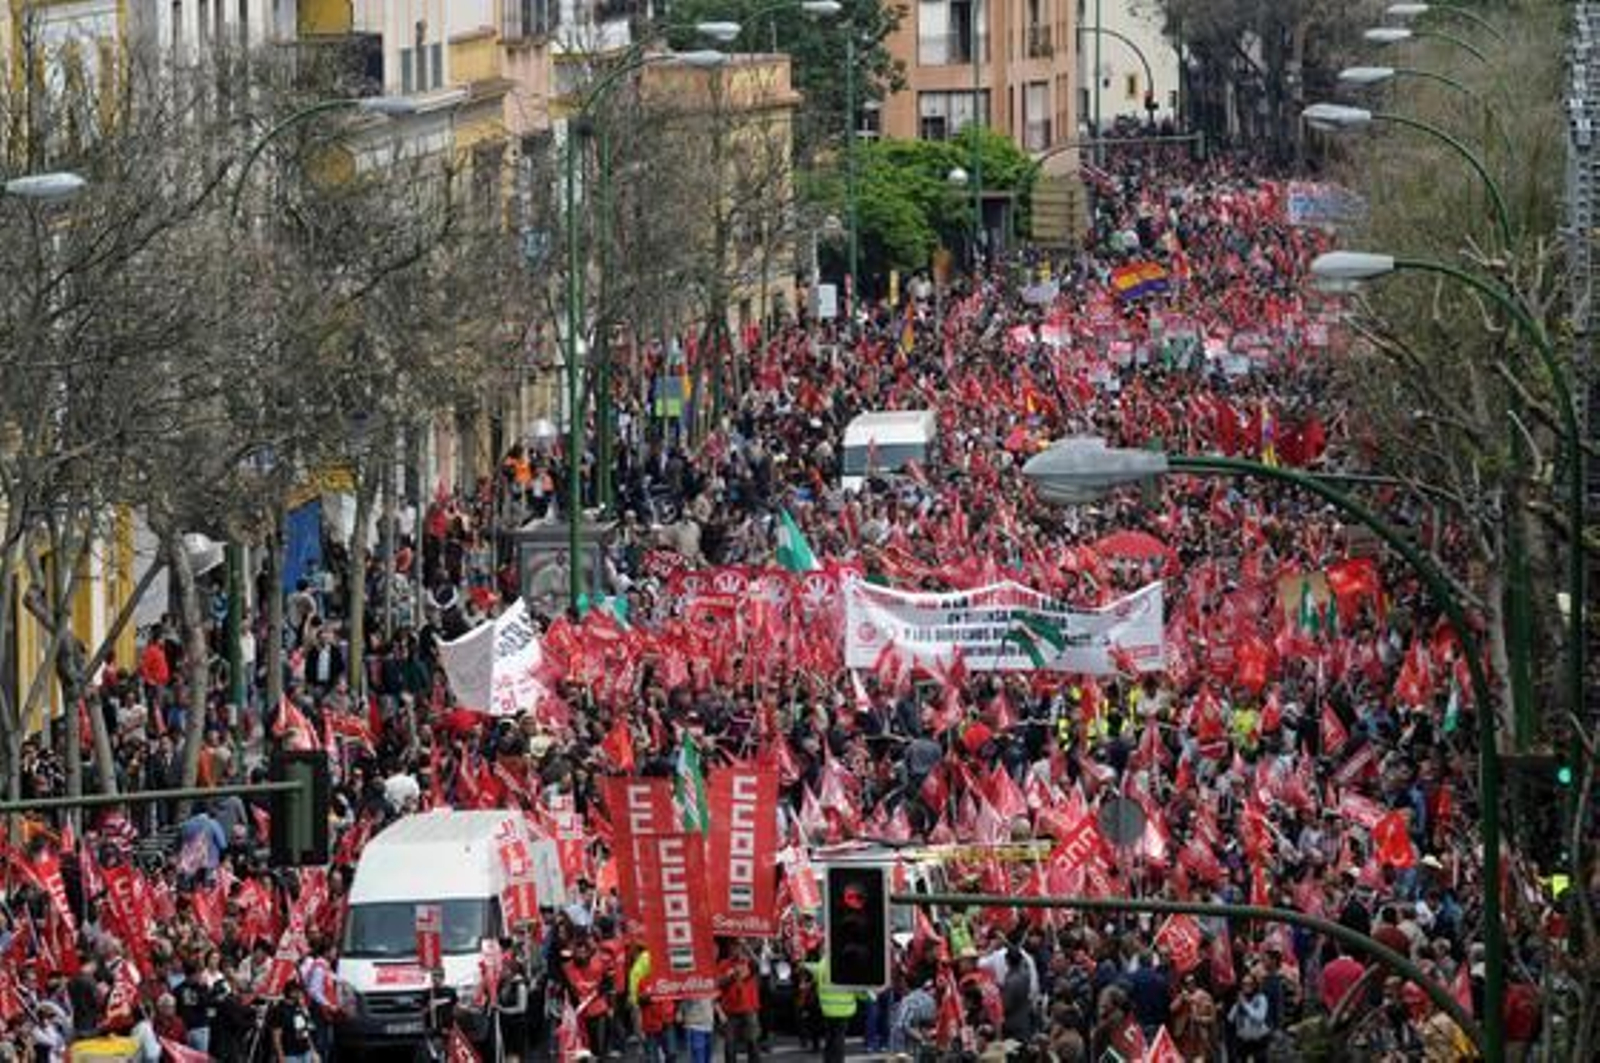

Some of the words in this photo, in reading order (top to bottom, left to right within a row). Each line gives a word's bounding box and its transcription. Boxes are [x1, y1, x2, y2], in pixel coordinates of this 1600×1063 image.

[729, 775, 757, 884] CCOO
[658, 838, 692, 945] CCOO
[712, 913, 770, 931] Sevilla
